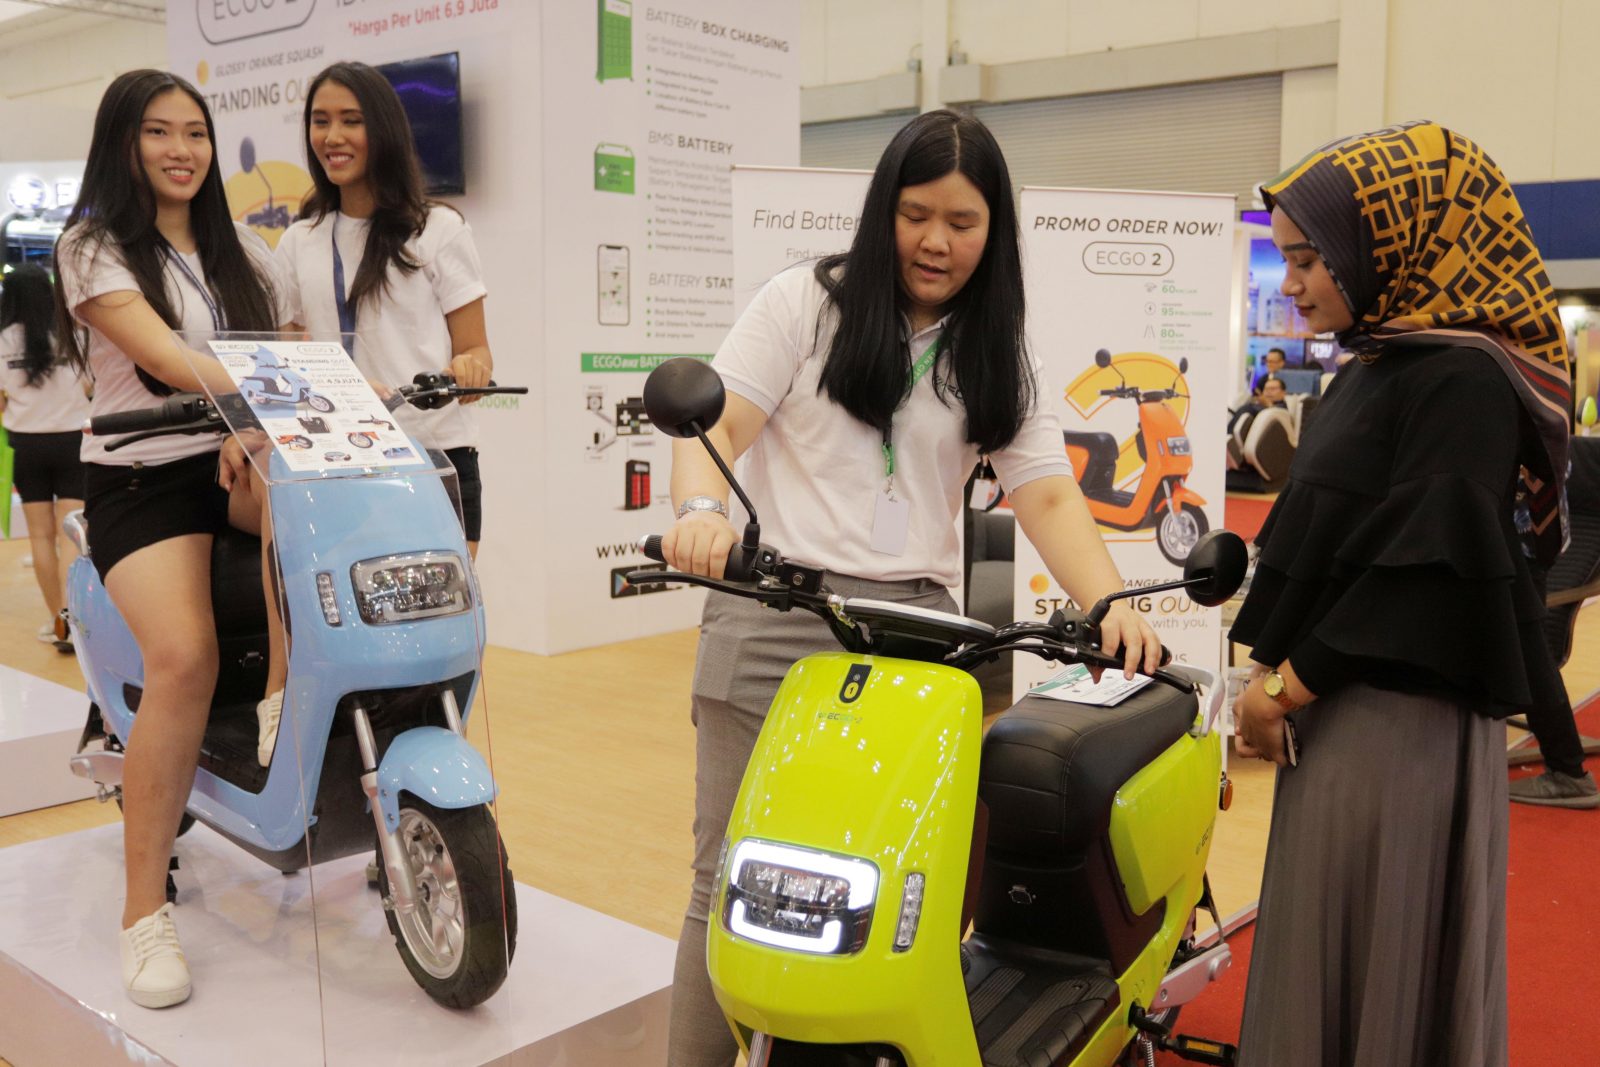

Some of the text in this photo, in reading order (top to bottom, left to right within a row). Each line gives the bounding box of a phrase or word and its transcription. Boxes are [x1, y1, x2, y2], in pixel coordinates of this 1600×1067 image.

[391, 12, 411, 29] Per
[414, 7, 441, 24] Unit
[646, 7, 789, 53] BATTERY BOX CHARGING
[215, 45, 324, 78] GLOSSY ORANGE SQUASH
[204, 78, 310, 113] TANDING OU
[649, 131, 734, 155] BMS BATTERY
[753, 209, 861, 231] Find Batter
[1033, 216, 1223, 237] PROMO ORDER NOW!
[785, 247, 810, 260] Find
[1096, 251, 1162, 267] ECGO 2
[649, 272, 734, 289] BATTERY STAT
[1160, 328, 1175, 338] 80
[640, 355, 668, 368] BATT
[1152, 616, 1208, 631] with you.
